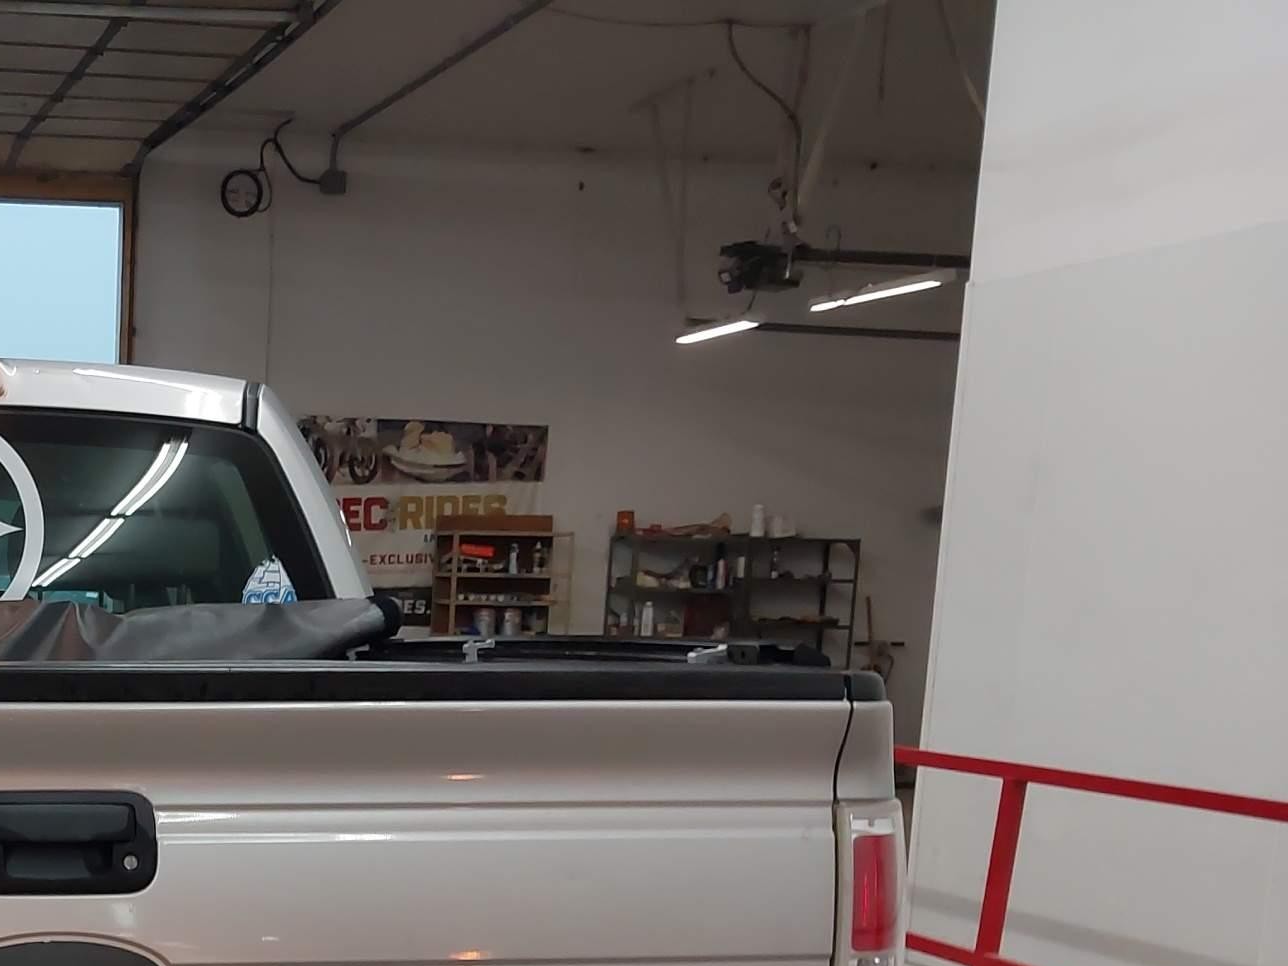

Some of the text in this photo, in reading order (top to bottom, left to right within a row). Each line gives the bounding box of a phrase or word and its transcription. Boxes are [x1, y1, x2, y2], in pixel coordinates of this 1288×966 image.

[336, 495, 508, 531] EC RIDES
[395, 599, 431, 615] ES.
